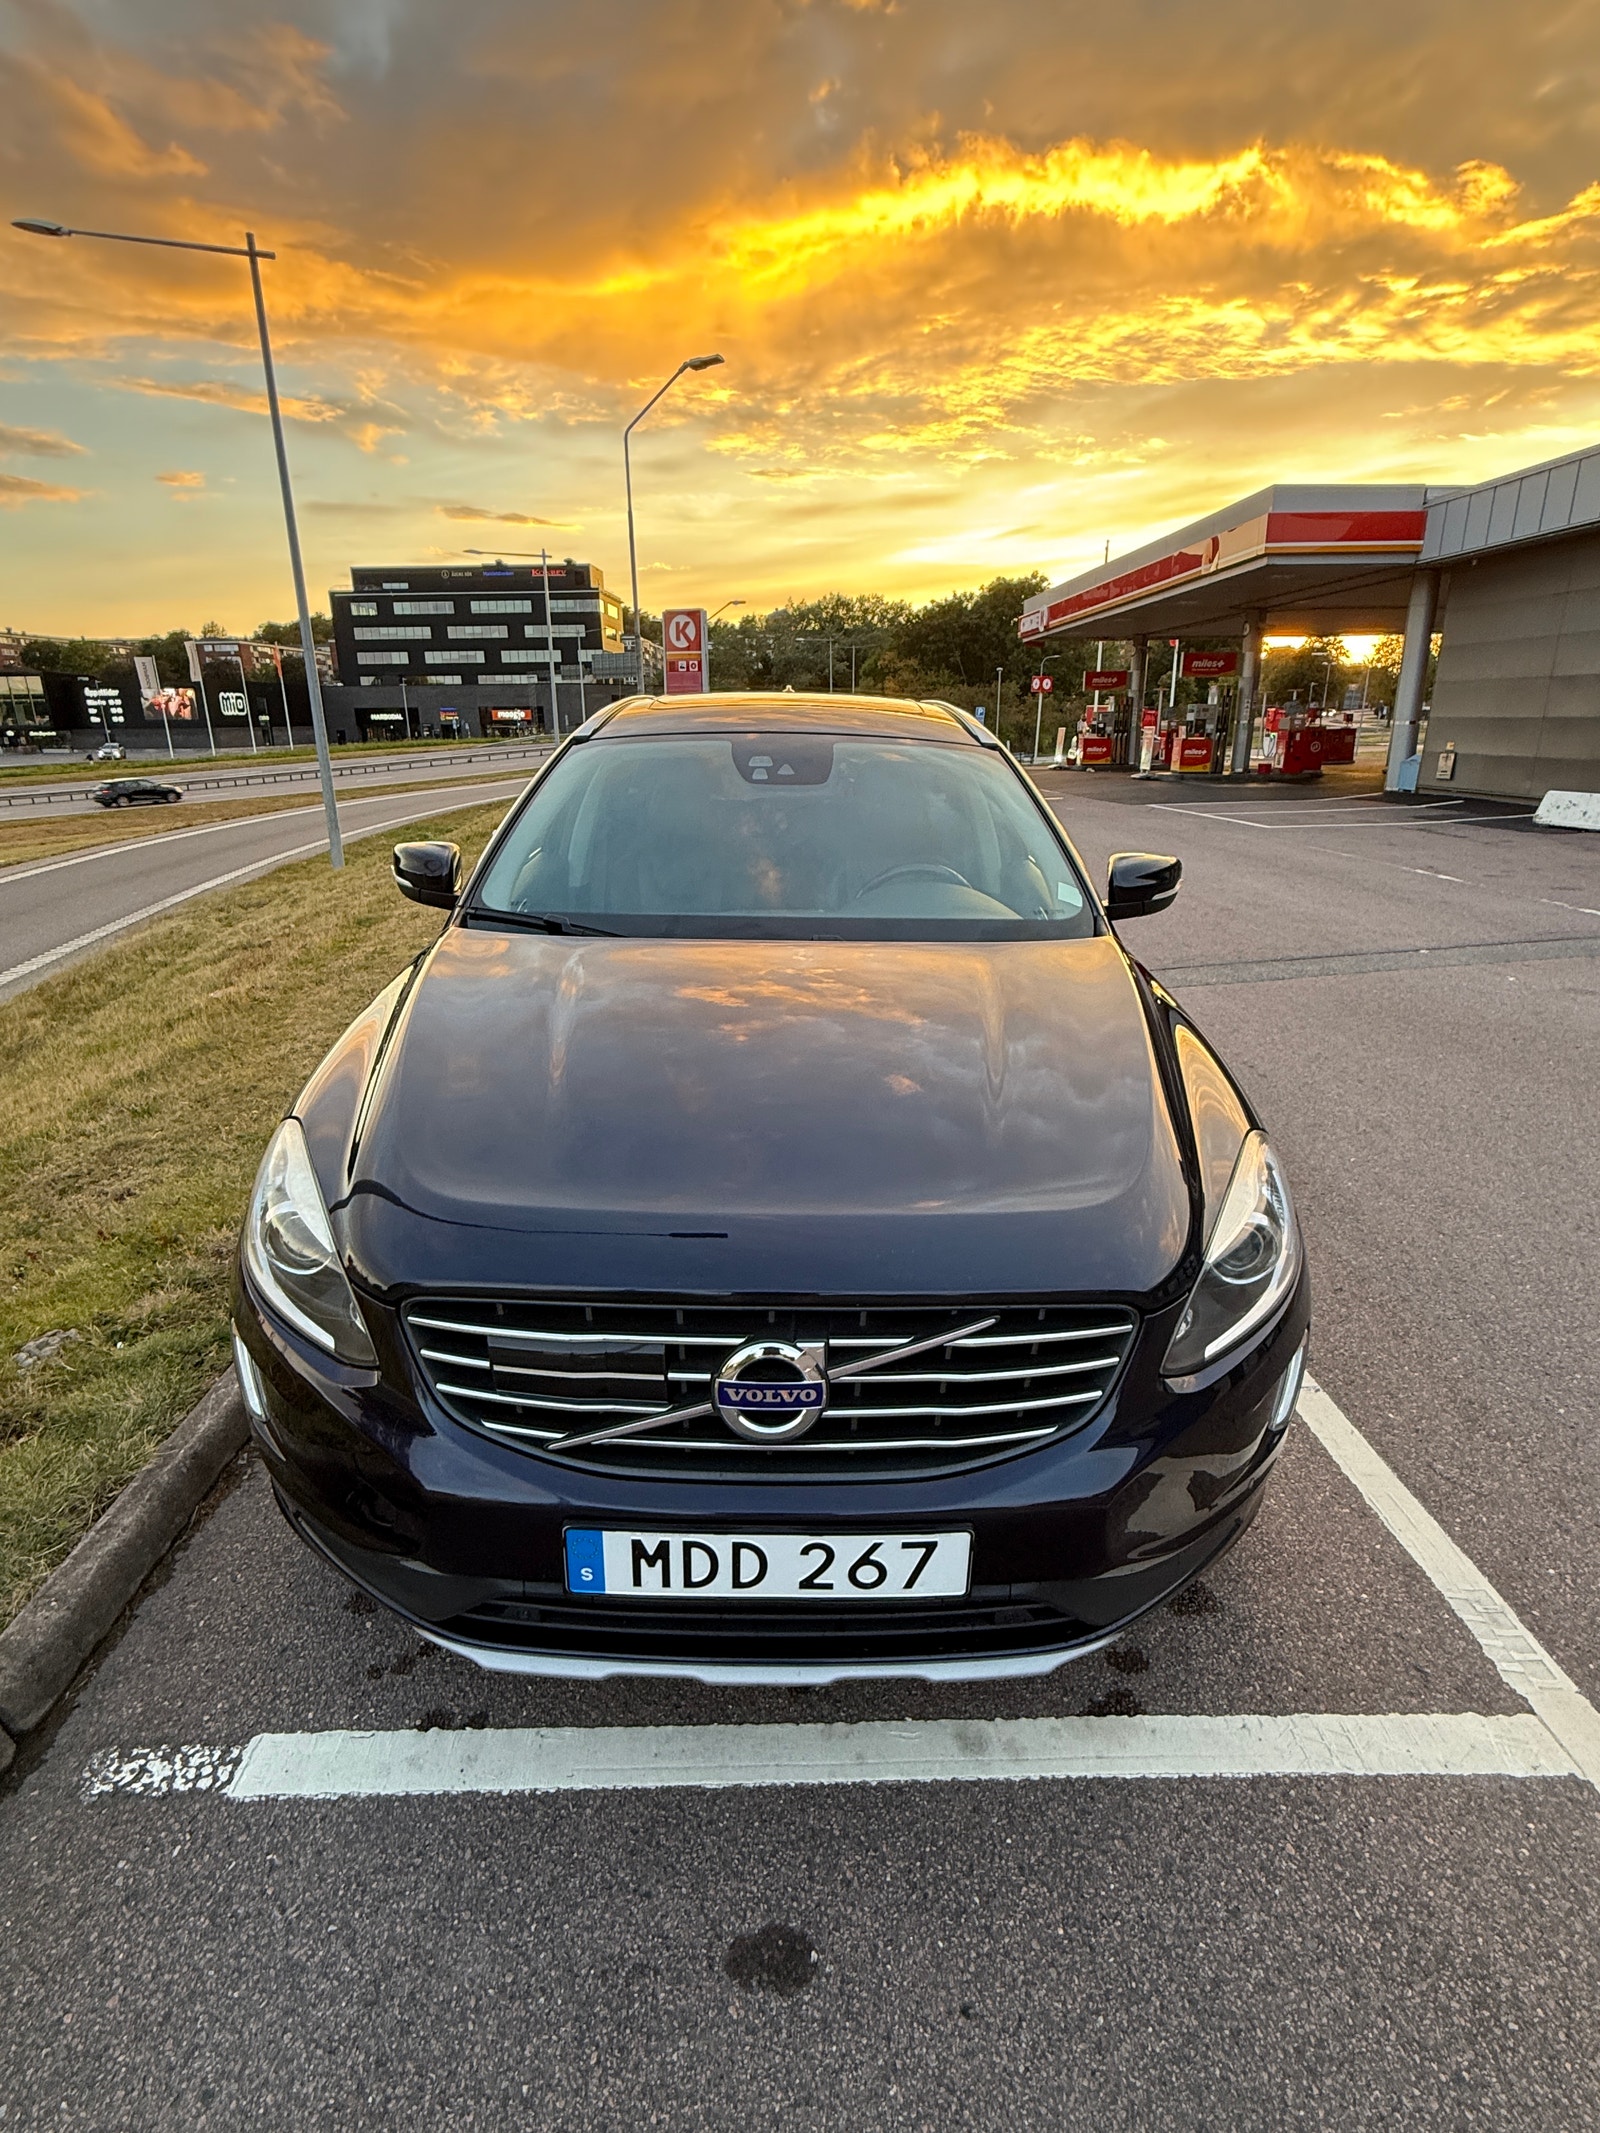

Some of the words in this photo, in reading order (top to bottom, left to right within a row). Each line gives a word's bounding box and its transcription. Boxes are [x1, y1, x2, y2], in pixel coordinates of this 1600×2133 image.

[674, 620, 693, 645] K
[724, 1388, 817, 1402] VOLVO
[580, 1567, 593, 1581] S
[631, 1539, 768, 1589] MDD
[798, 1541, 938, 1590] 267
